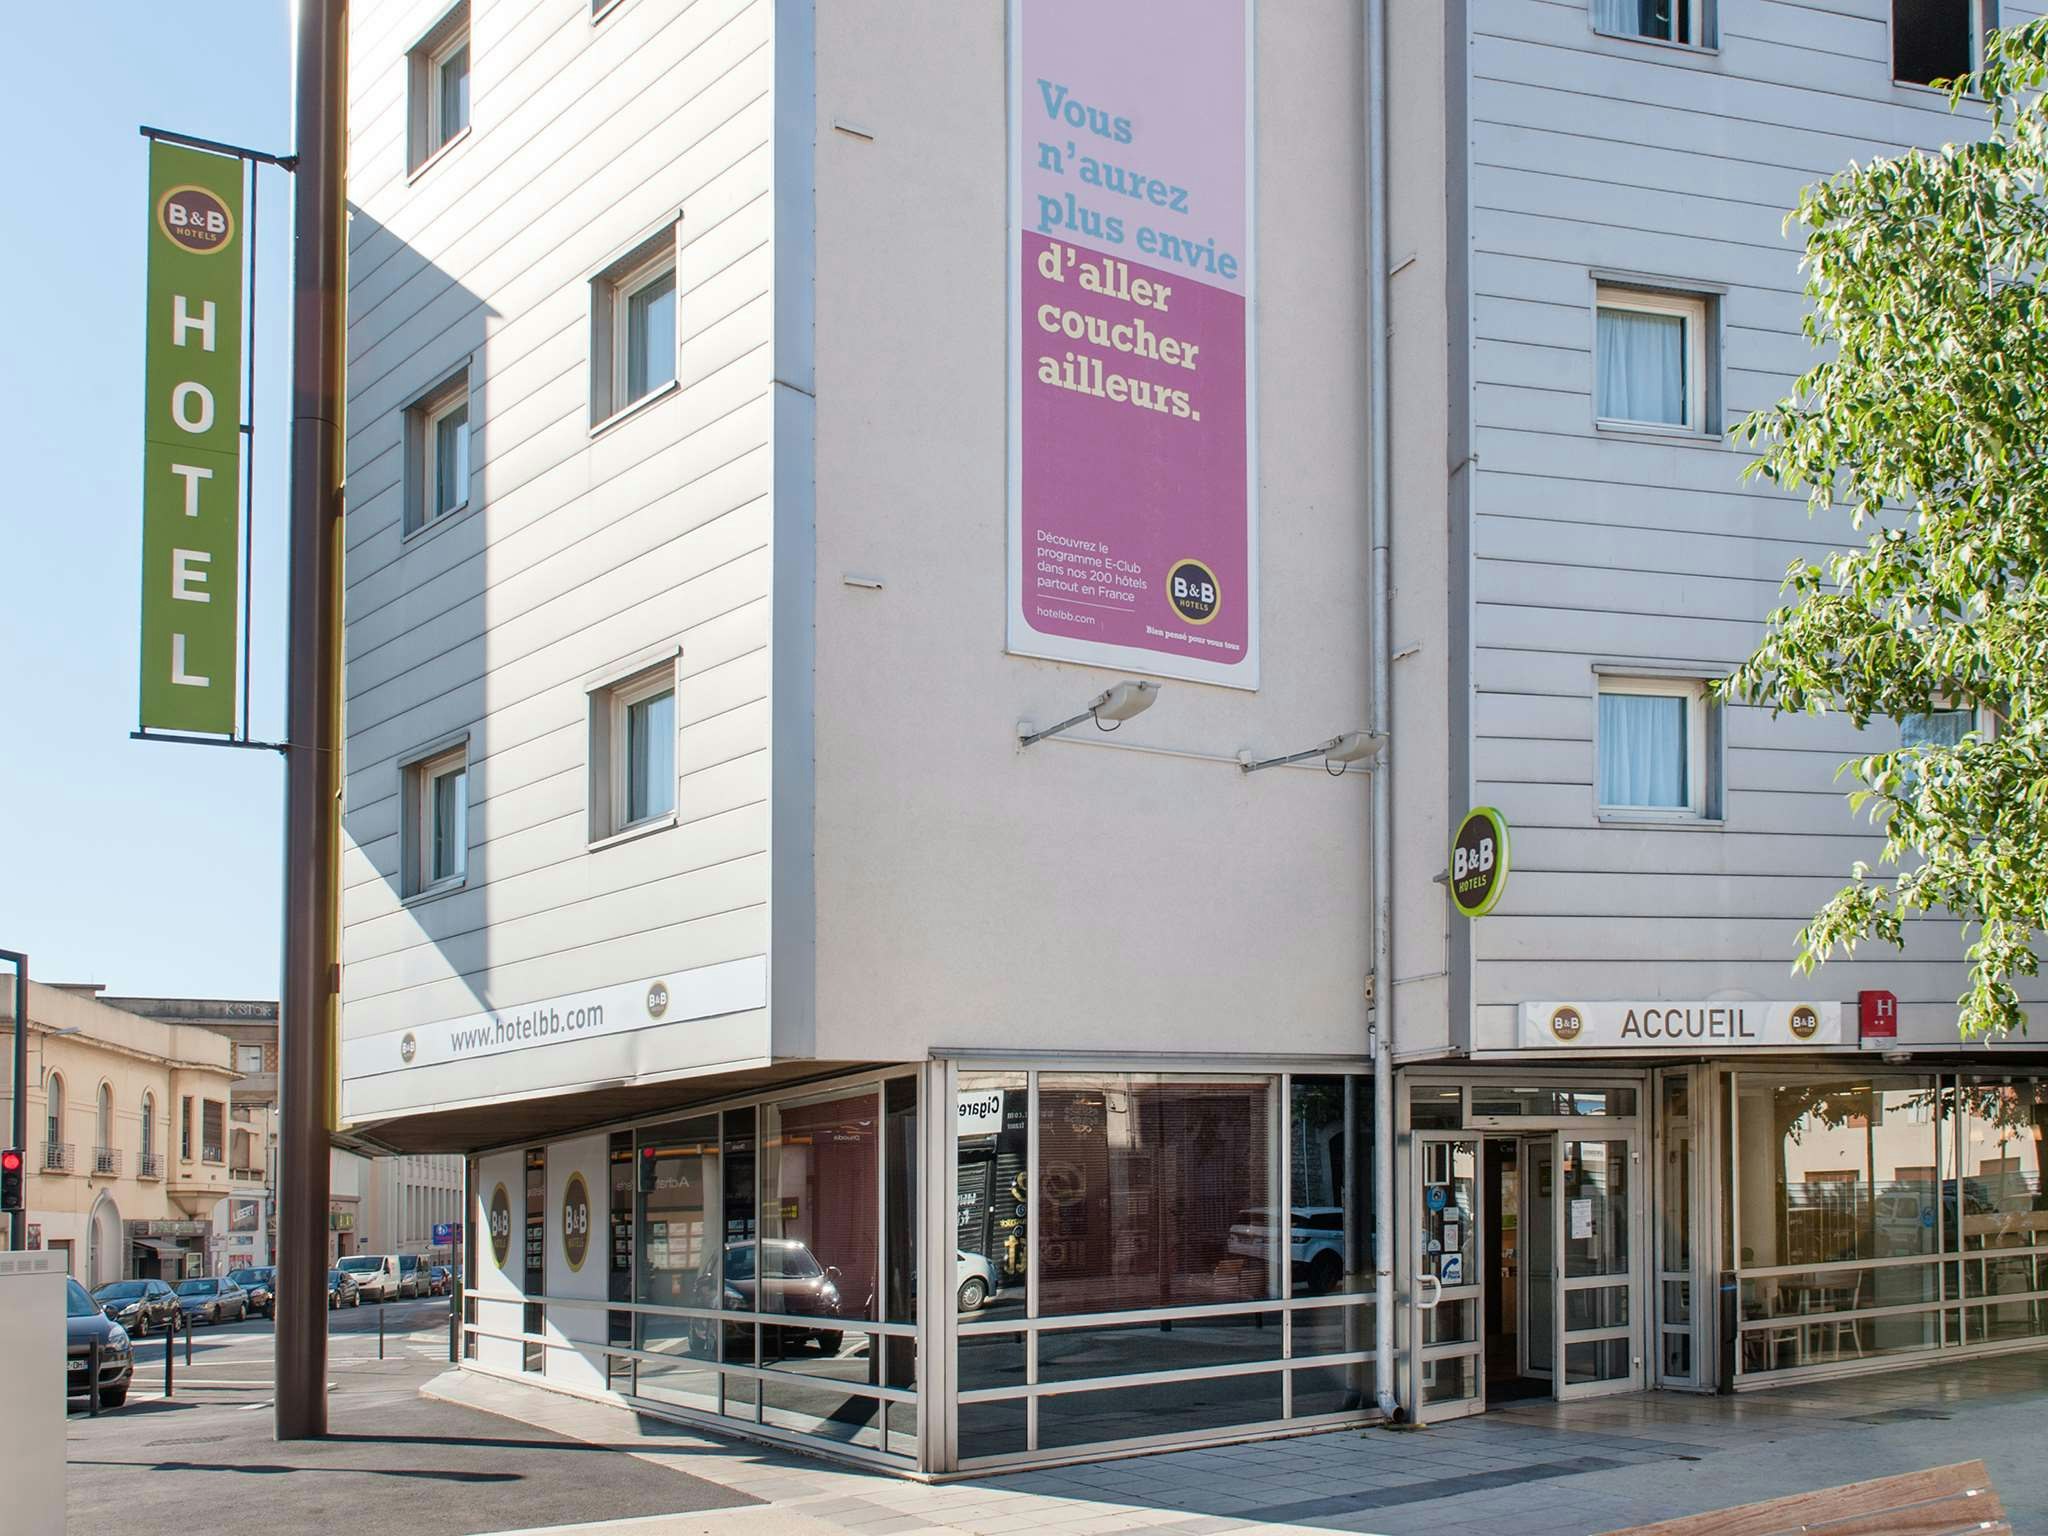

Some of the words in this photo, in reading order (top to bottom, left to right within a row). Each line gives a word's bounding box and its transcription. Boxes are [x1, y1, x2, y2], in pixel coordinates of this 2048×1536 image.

[1037, 78, 1133, 144] Vous
[1038, 141, 1189, 215] n’aurez
[169, 203, 226, 234] B&B
[176, 227, 217, 241] HOTELS
[1037, 192, 1125, 244] plus
[1136, 225, 1238, 280] envie
[1038, 243, 1172, 312] d’aller
[1038, 304, 1199, 370] coucher
[1038, 352, 1200, 421] ailleurs.
[172, 295, 216, 687] HOTEL
[1037, 529, 1096, 552] Découvrez
[1098, 542, 1109, 554] le
[1037, 547, 1102, 567] programme
[1104, 558, 1141, 574] E-Club
[1037, 561, 1064, 575] dans
[1067, 567, 1087, 579] nos
[1089, 570, 1112, 582] 200
[1115, 574, 1148, 589] hôtels
[1037, 577, 1079, 593] partout
[1081, 585, 1095, 596] en
[1098, 586, 1135, 602] France
[1174, 577, 1214, 603] B&B
[1037, 606, 1096, 624] hotelbb.com
[1180, 600, 1208, 611] HOTELS
[1146, 625, 1164, 636] Bien
[1454, 838, 1494, 881] B&B
[1459, 874, 1487, 893] HOTELS
[649, 991, 667, 1007] B&B
[1877, 1000, 1893, 1017] H
[451, 1004, 604, 1052] www.hotelbb.com
[1554, 1017, 1579, 1029] B&B
[1620, 1009, 1755, 1038] ACCUEIL
[1793, 1016, 1816, 1028] B&B
[402, 1040, 415, 1053] B&B
[491, 1210, 509, 1236] B&B
[565, 1204, 587, 1235] B&B
